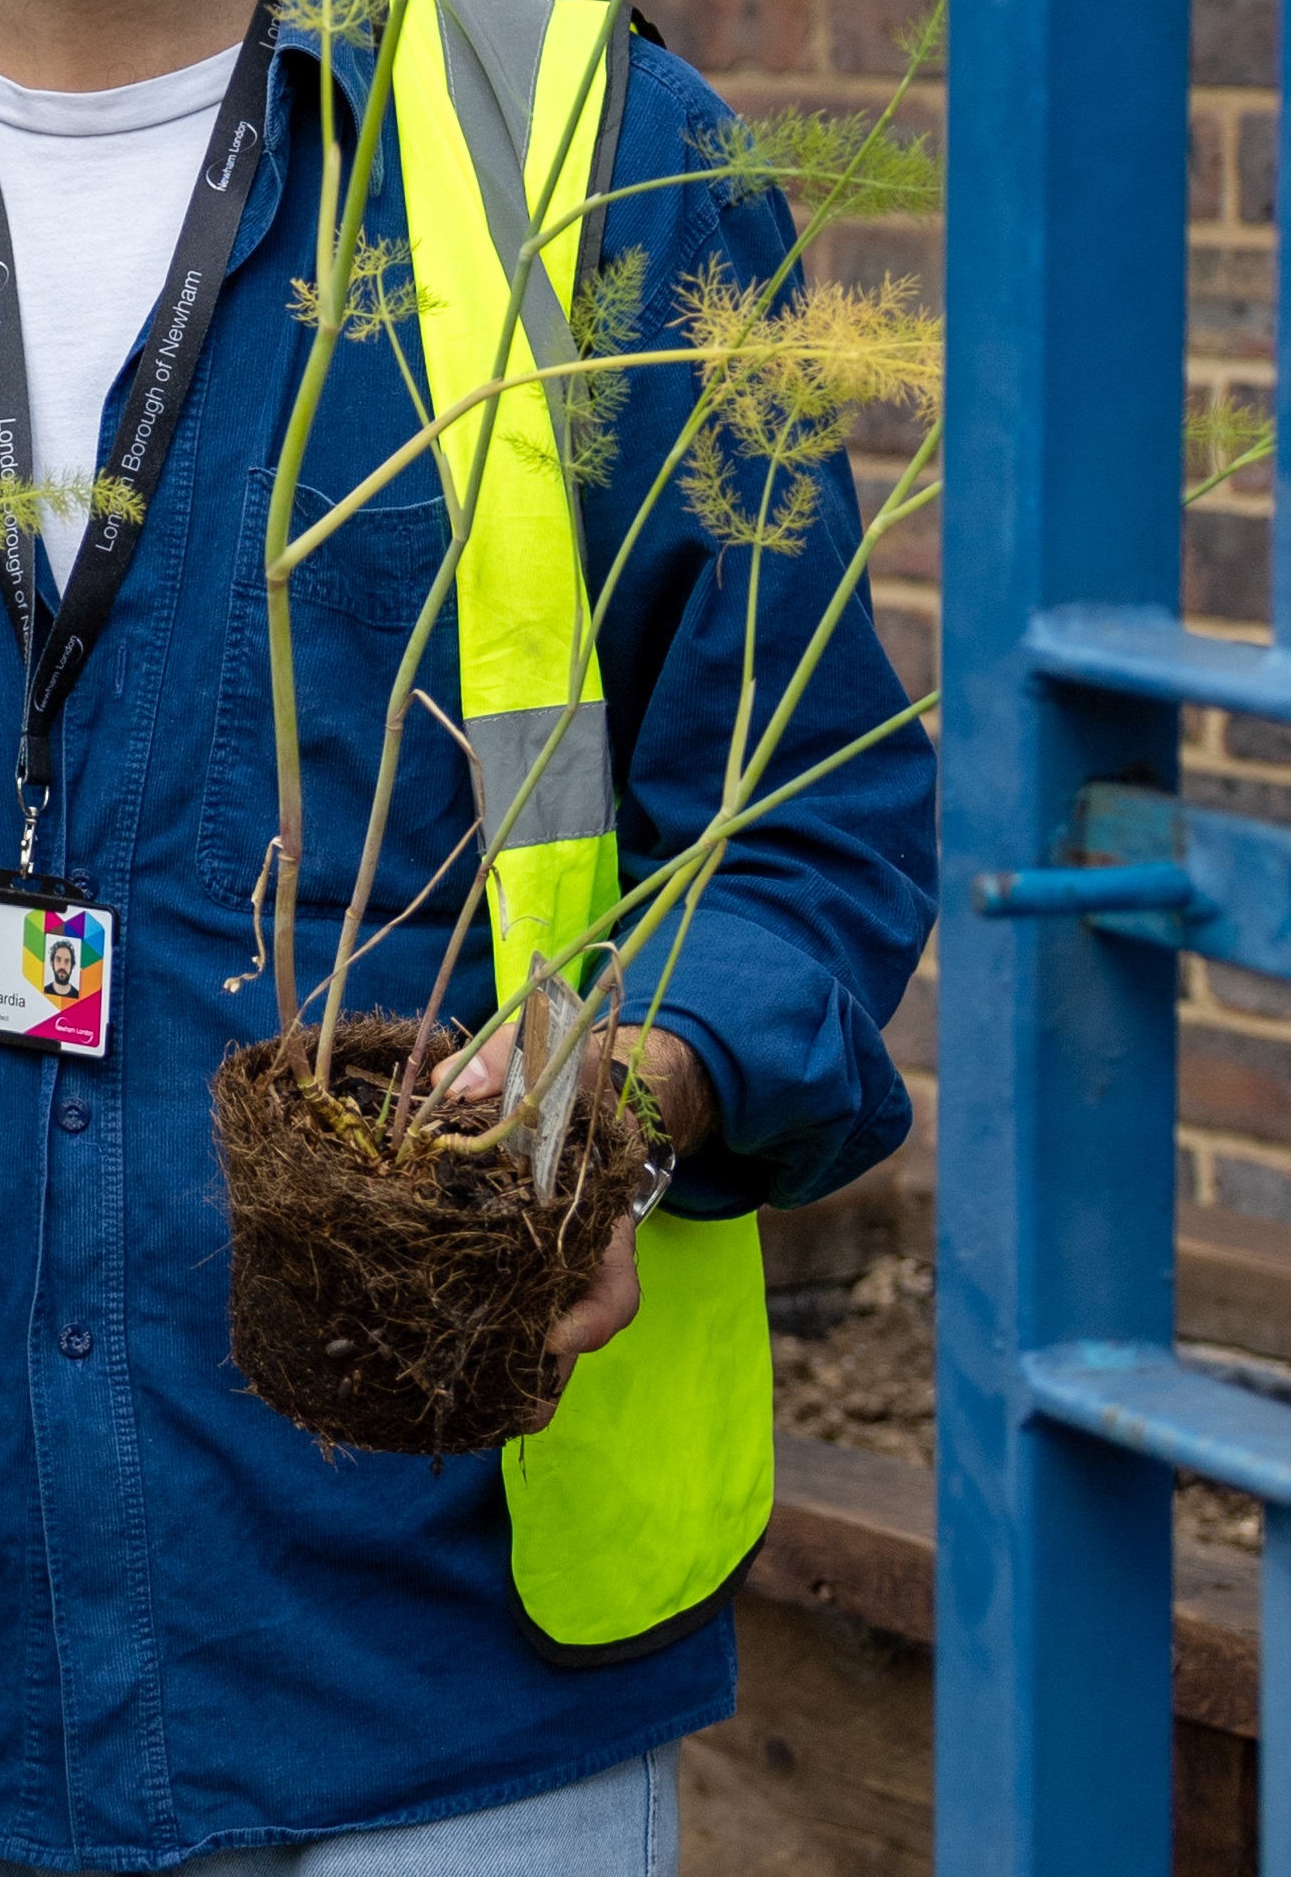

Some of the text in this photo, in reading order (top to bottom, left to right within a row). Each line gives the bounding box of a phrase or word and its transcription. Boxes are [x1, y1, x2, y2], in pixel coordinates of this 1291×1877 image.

[229, 120, 247, 154] London
[158, 269, 203, 358] Newham
[155, 356, 173, 382] of
[121, 385, 165, 472] Borough
[15, 590, 28, 609] of
[55, 635, 77, 670] London
